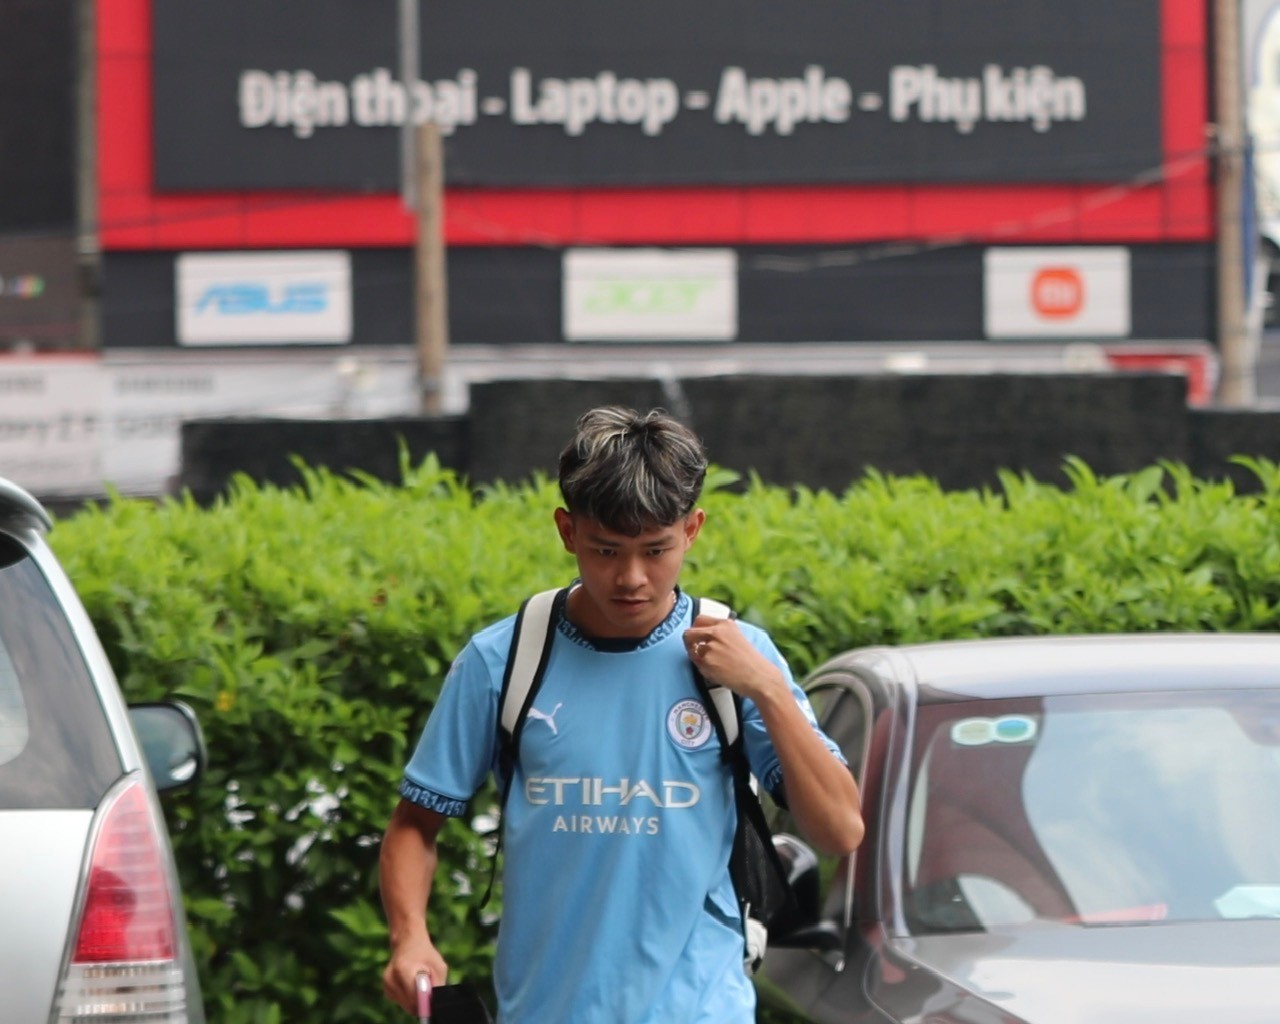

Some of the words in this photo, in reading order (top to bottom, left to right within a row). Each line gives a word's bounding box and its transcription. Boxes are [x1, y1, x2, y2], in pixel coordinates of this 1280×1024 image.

[511, 67, 679, 136] Laptop
[714, 66, 852, 136] Apple
[890, 64, 981, 134] Phụ
[194, 282, 327, 316] ASUS
[525, 777, 700, 808] ETIHAD
[553, 815, 659, 835] AIRWAYS
